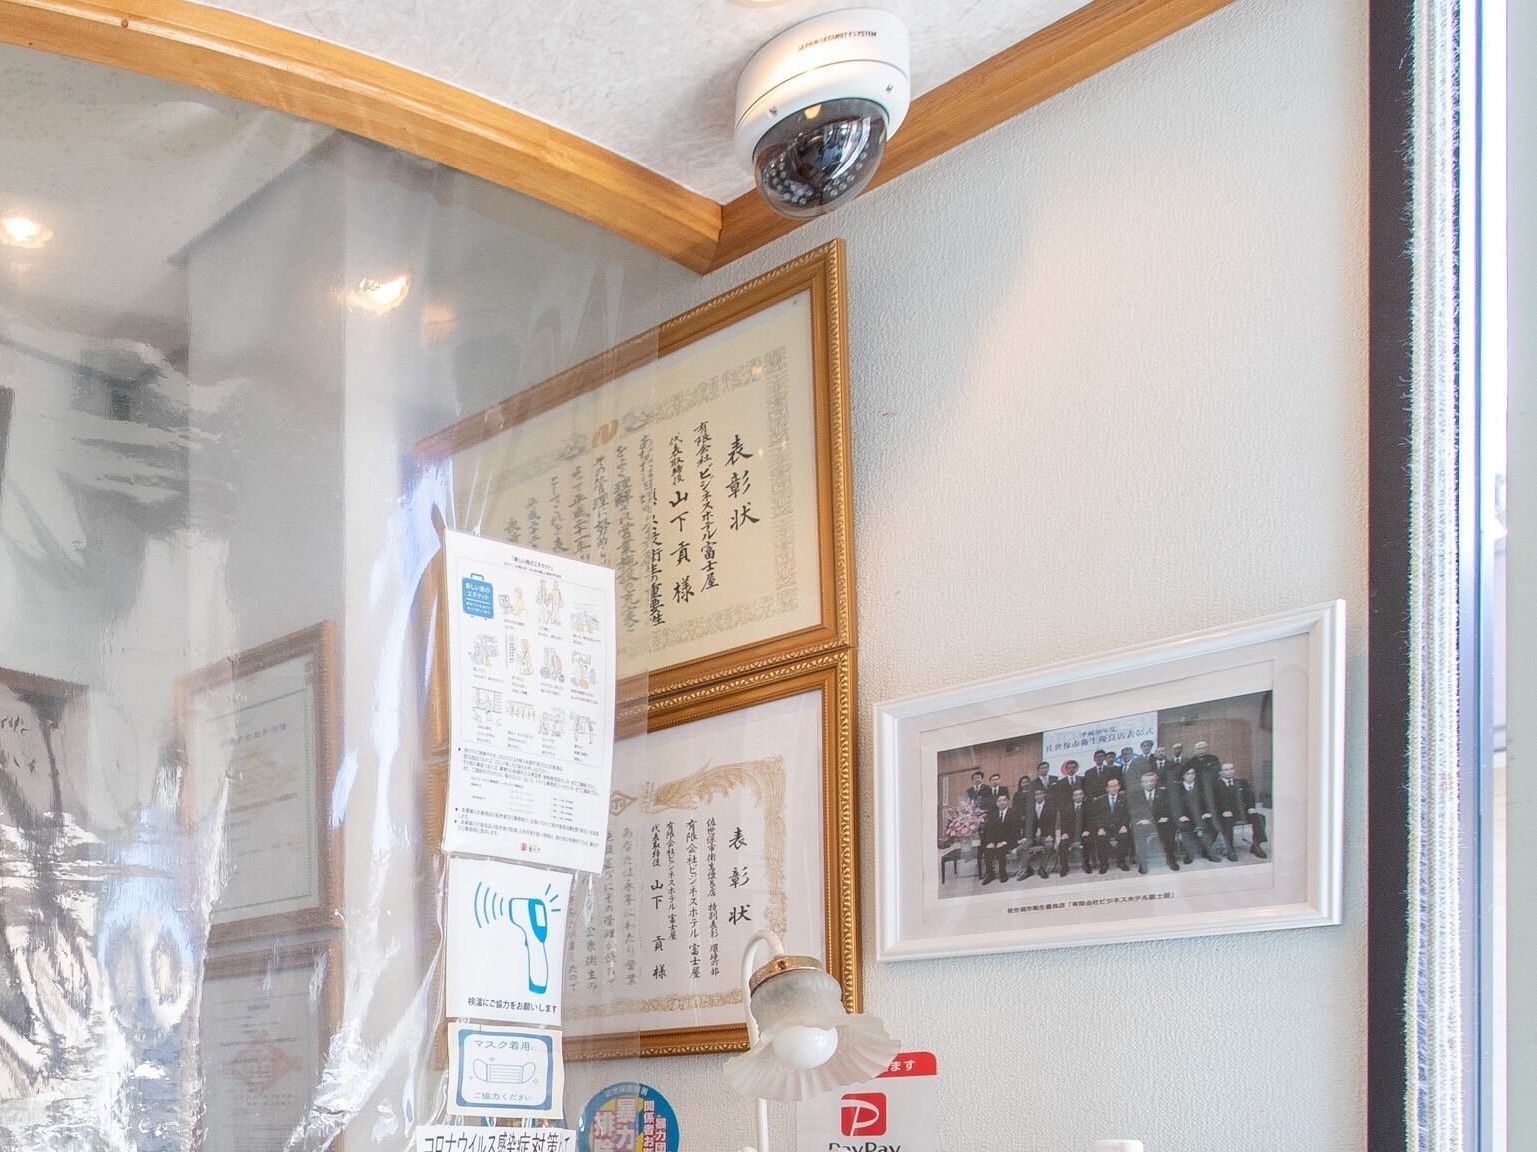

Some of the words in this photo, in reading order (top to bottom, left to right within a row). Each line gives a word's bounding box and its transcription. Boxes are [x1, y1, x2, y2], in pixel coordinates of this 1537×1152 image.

[724, 434, 760, 531] 表彰状
[728, 827, 751, 925] 表彰状
[468, 996, 557, 1014] 検温にご協力をお願いします
[473, 1091, 533, 1103] ご協力ください
